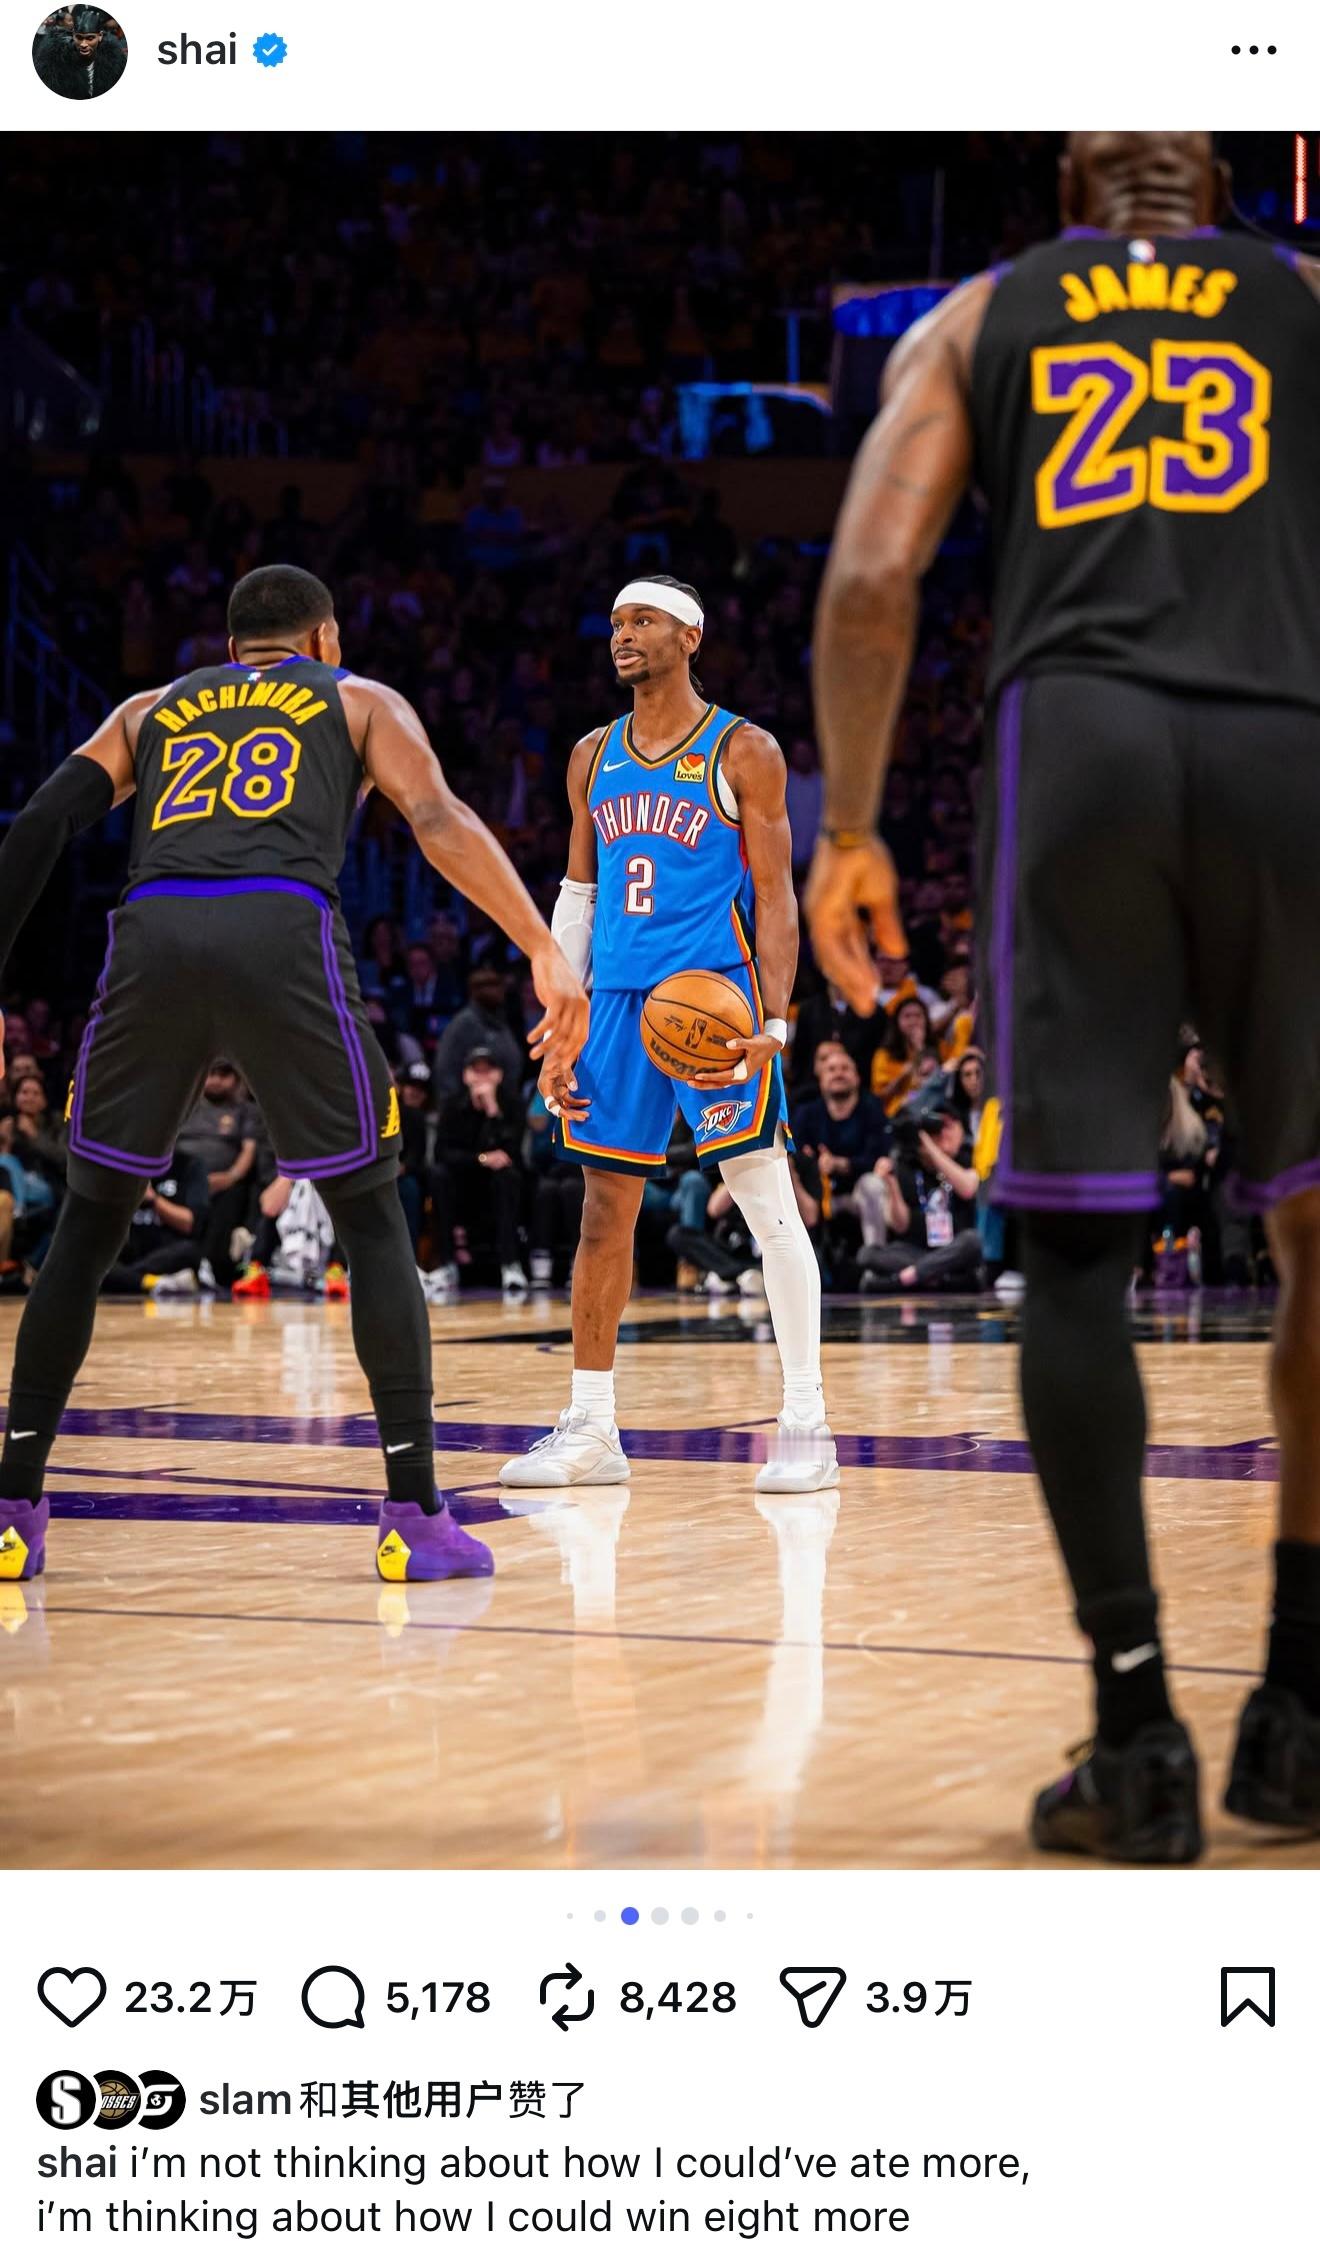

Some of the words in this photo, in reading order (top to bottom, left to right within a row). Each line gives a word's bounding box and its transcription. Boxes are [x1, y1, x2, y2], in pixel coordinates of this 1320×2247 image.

[1060, 262, 1238, 323] JAMES
[1031, 338, 1272, 530] 23
[153, 681, 329, 733] HACHIMURA
[151, 726, 302, 831] 28
[592, 791, 710, 852] THUNDER
[624, 854, 656, 916] 2
